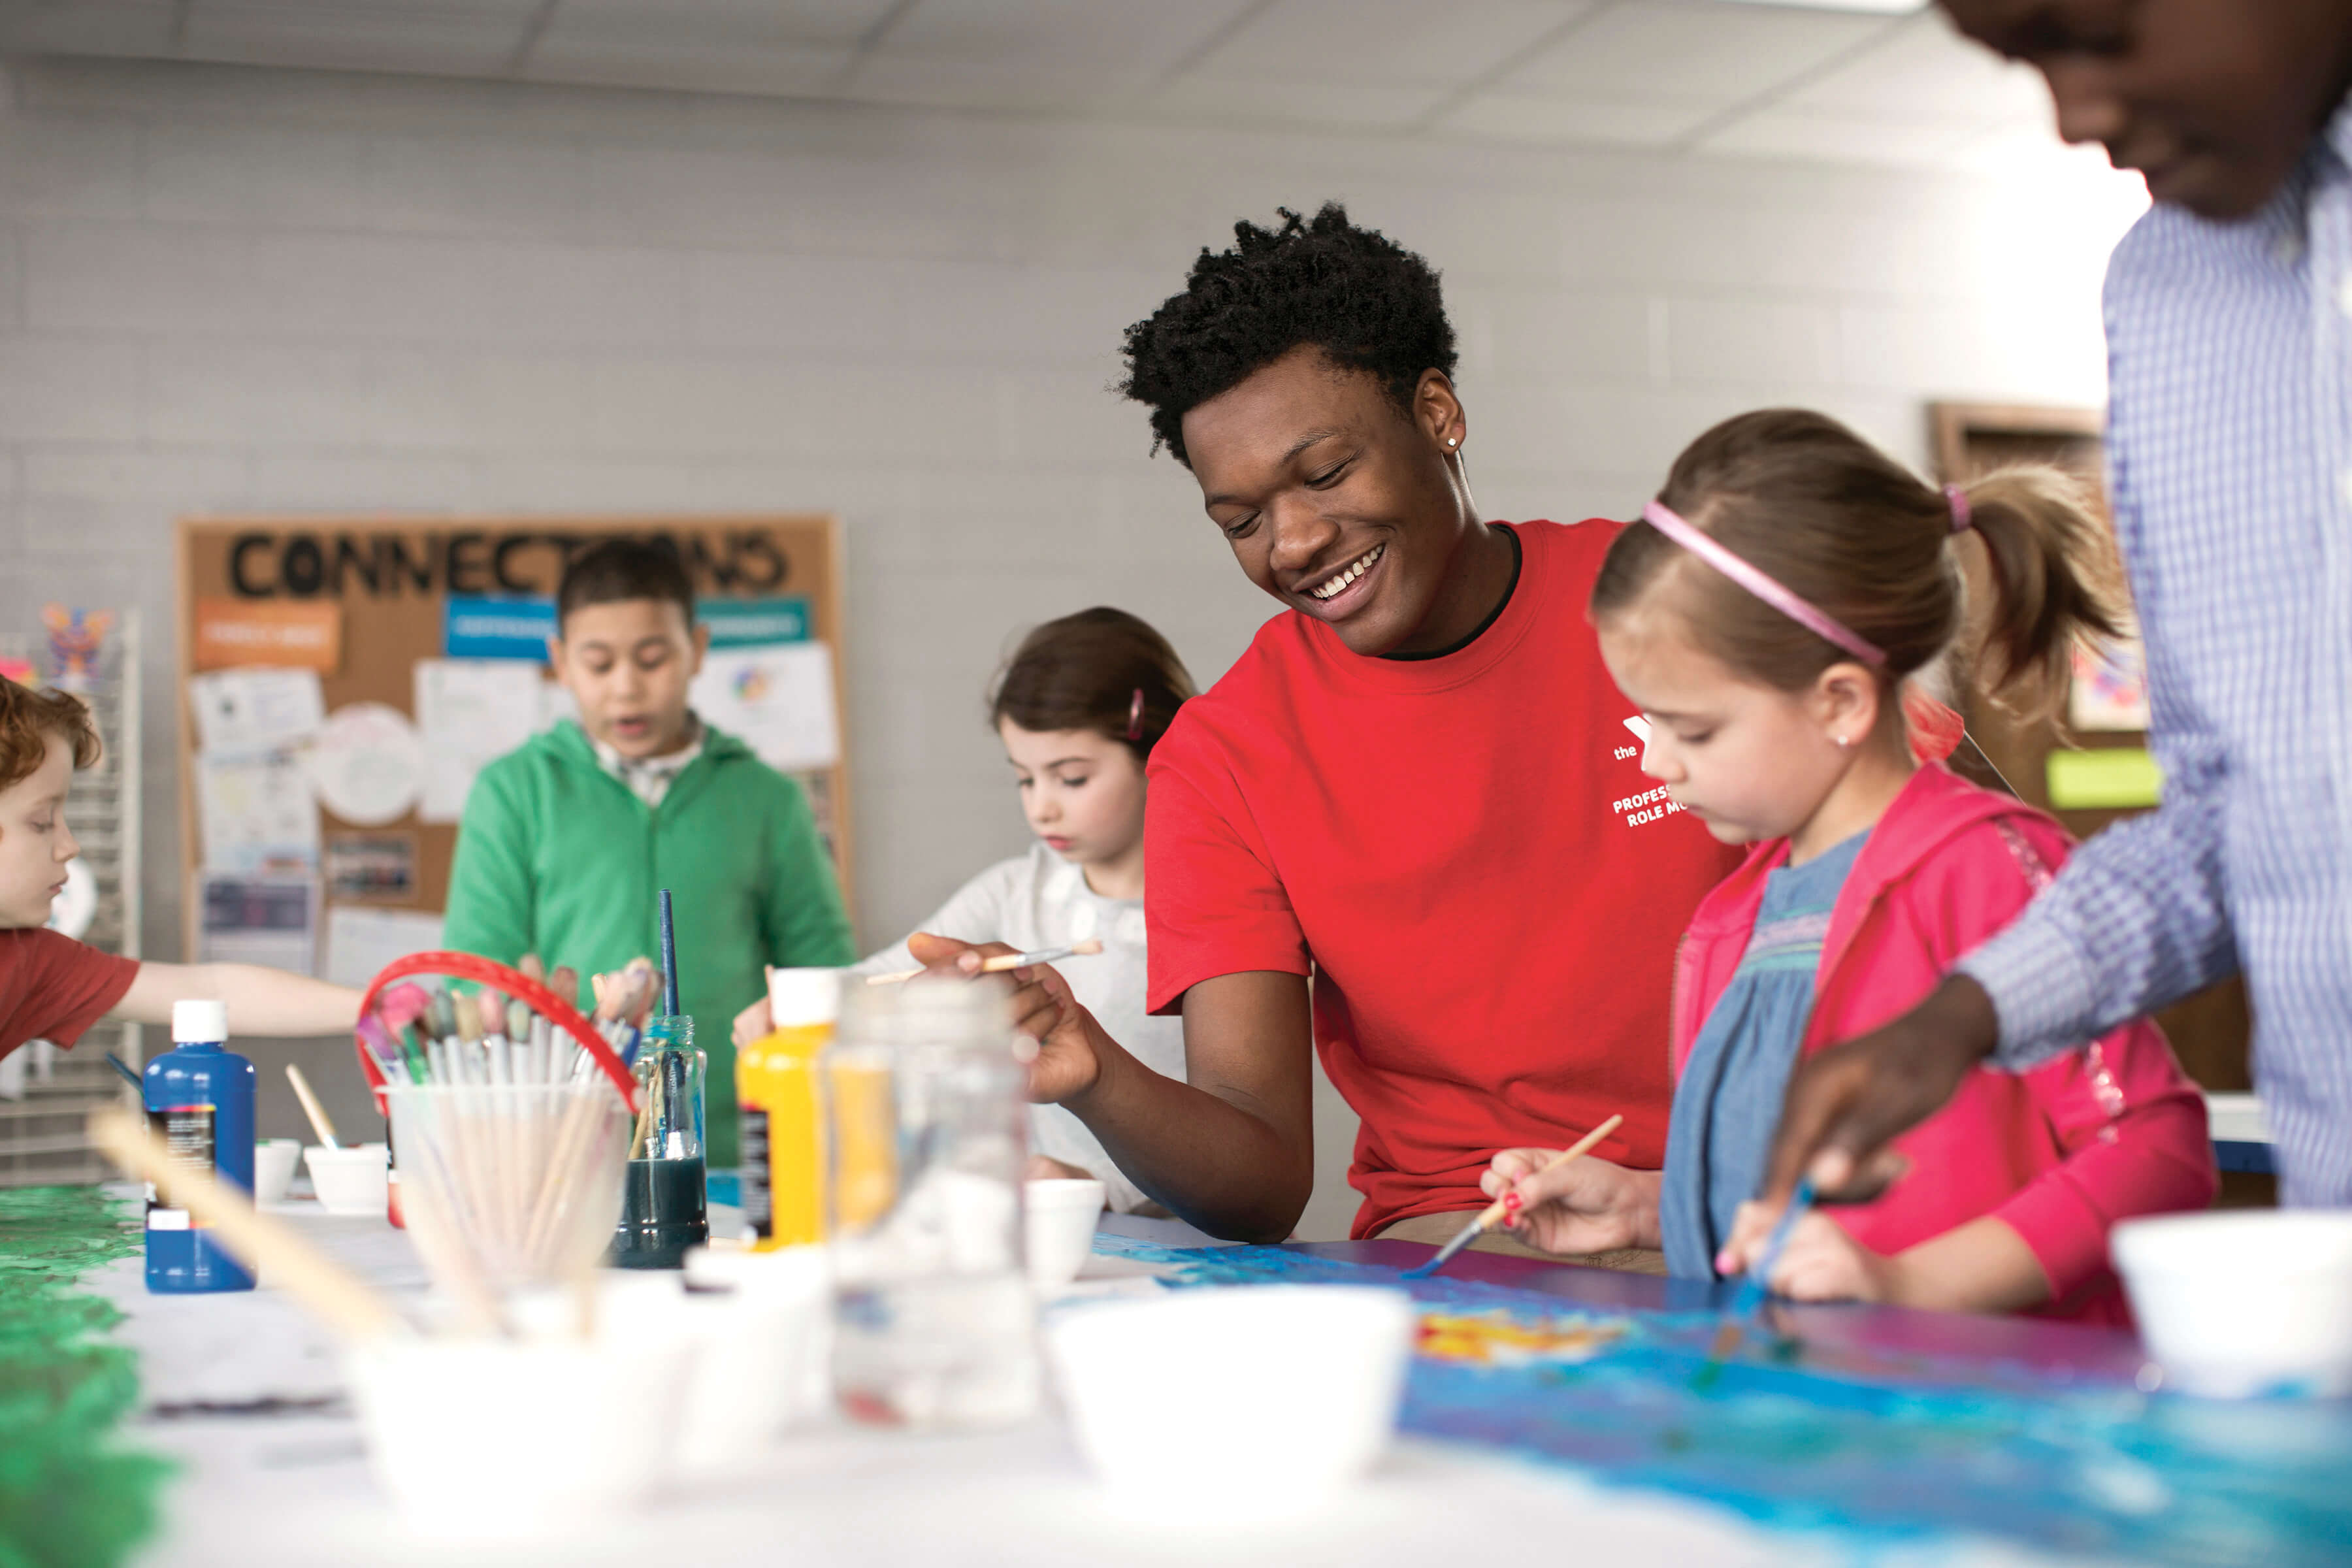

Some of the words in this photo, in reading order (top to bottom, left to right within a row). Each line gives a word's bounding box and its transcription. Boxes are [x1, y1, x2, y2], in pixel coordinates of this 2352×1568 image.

[229, 531, 791, 598] CONNECTNS
[1614, 746, 1637, 760] the
[1612, 783, 1671, 814] PROFES
[1627, 805, 1664, 828] ROLE
